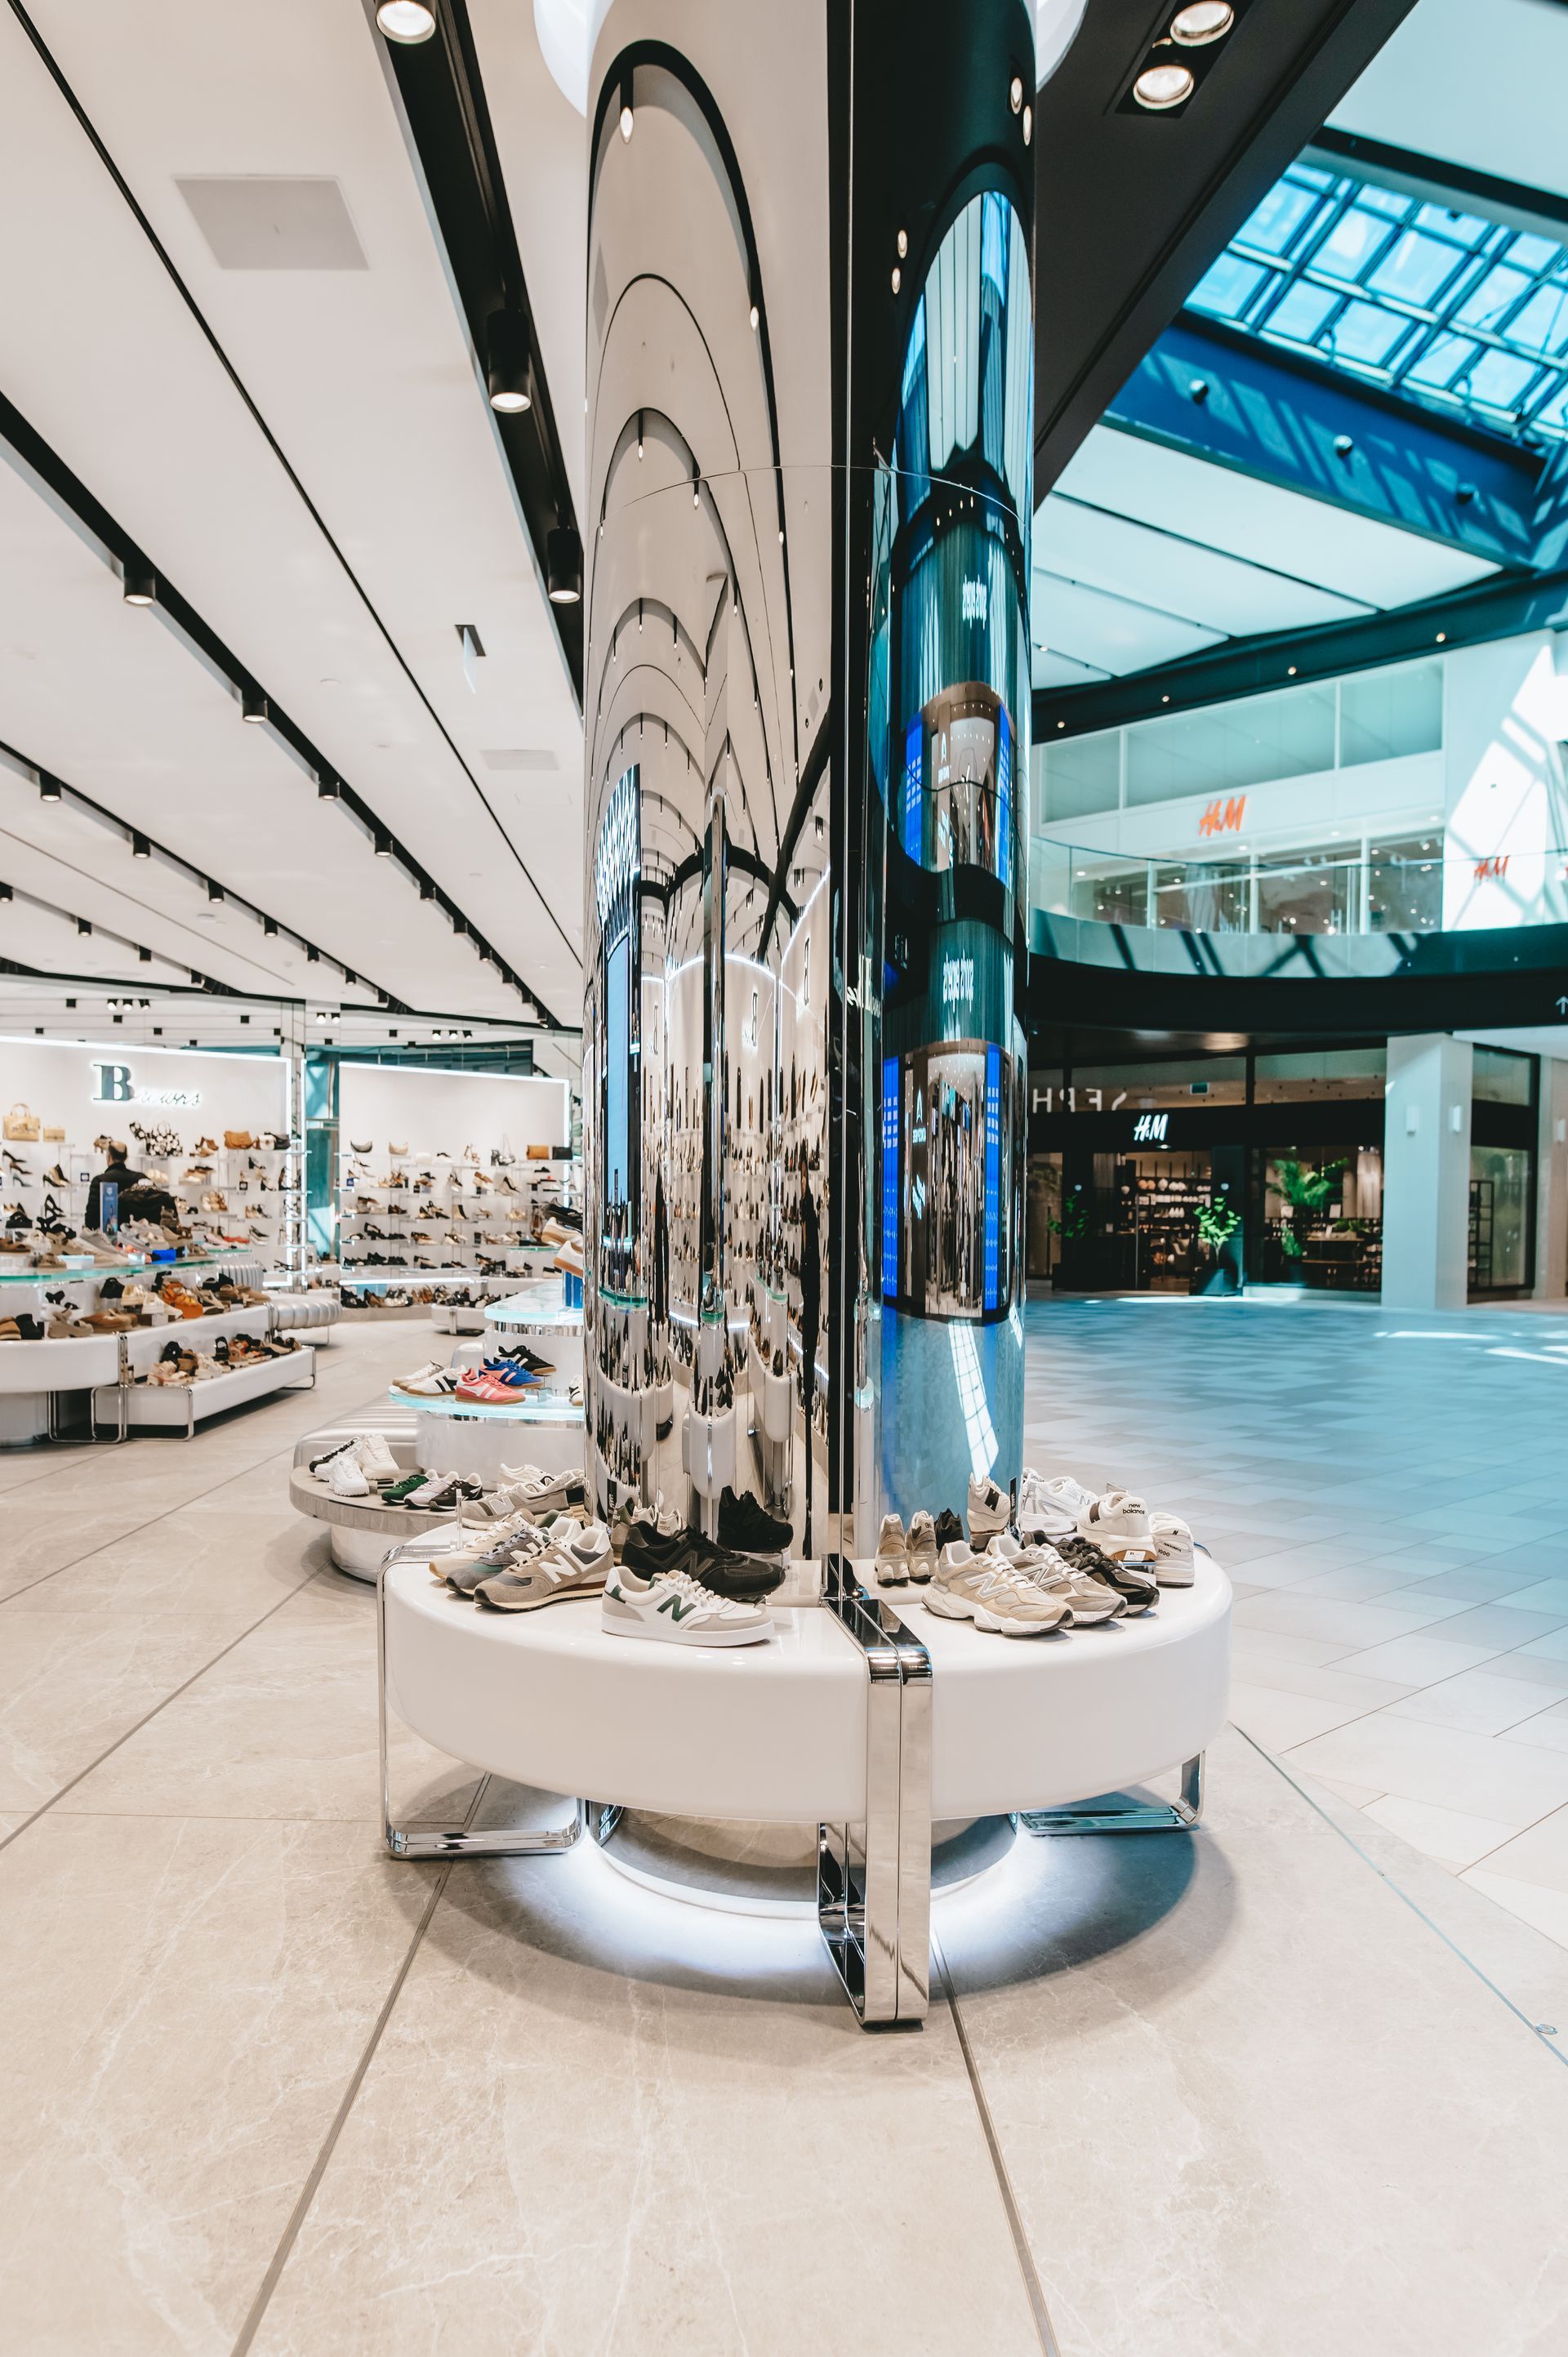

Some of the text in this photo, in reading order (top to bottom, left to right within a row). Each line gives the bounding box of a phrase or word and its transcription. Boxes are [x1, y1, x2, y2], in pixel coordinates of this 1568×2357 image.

[1197, 795, 1246, 836] H&M
[92, 1063, 202, 1106] Bwns
[1134, 1113, 1169, 1141] H&M
[489, 1495, 515, 1515] N
[538, 1553, 577, 1584] N
[964, 1571, 1011, 1599] N
[657, 1593, 697, 1623] N
